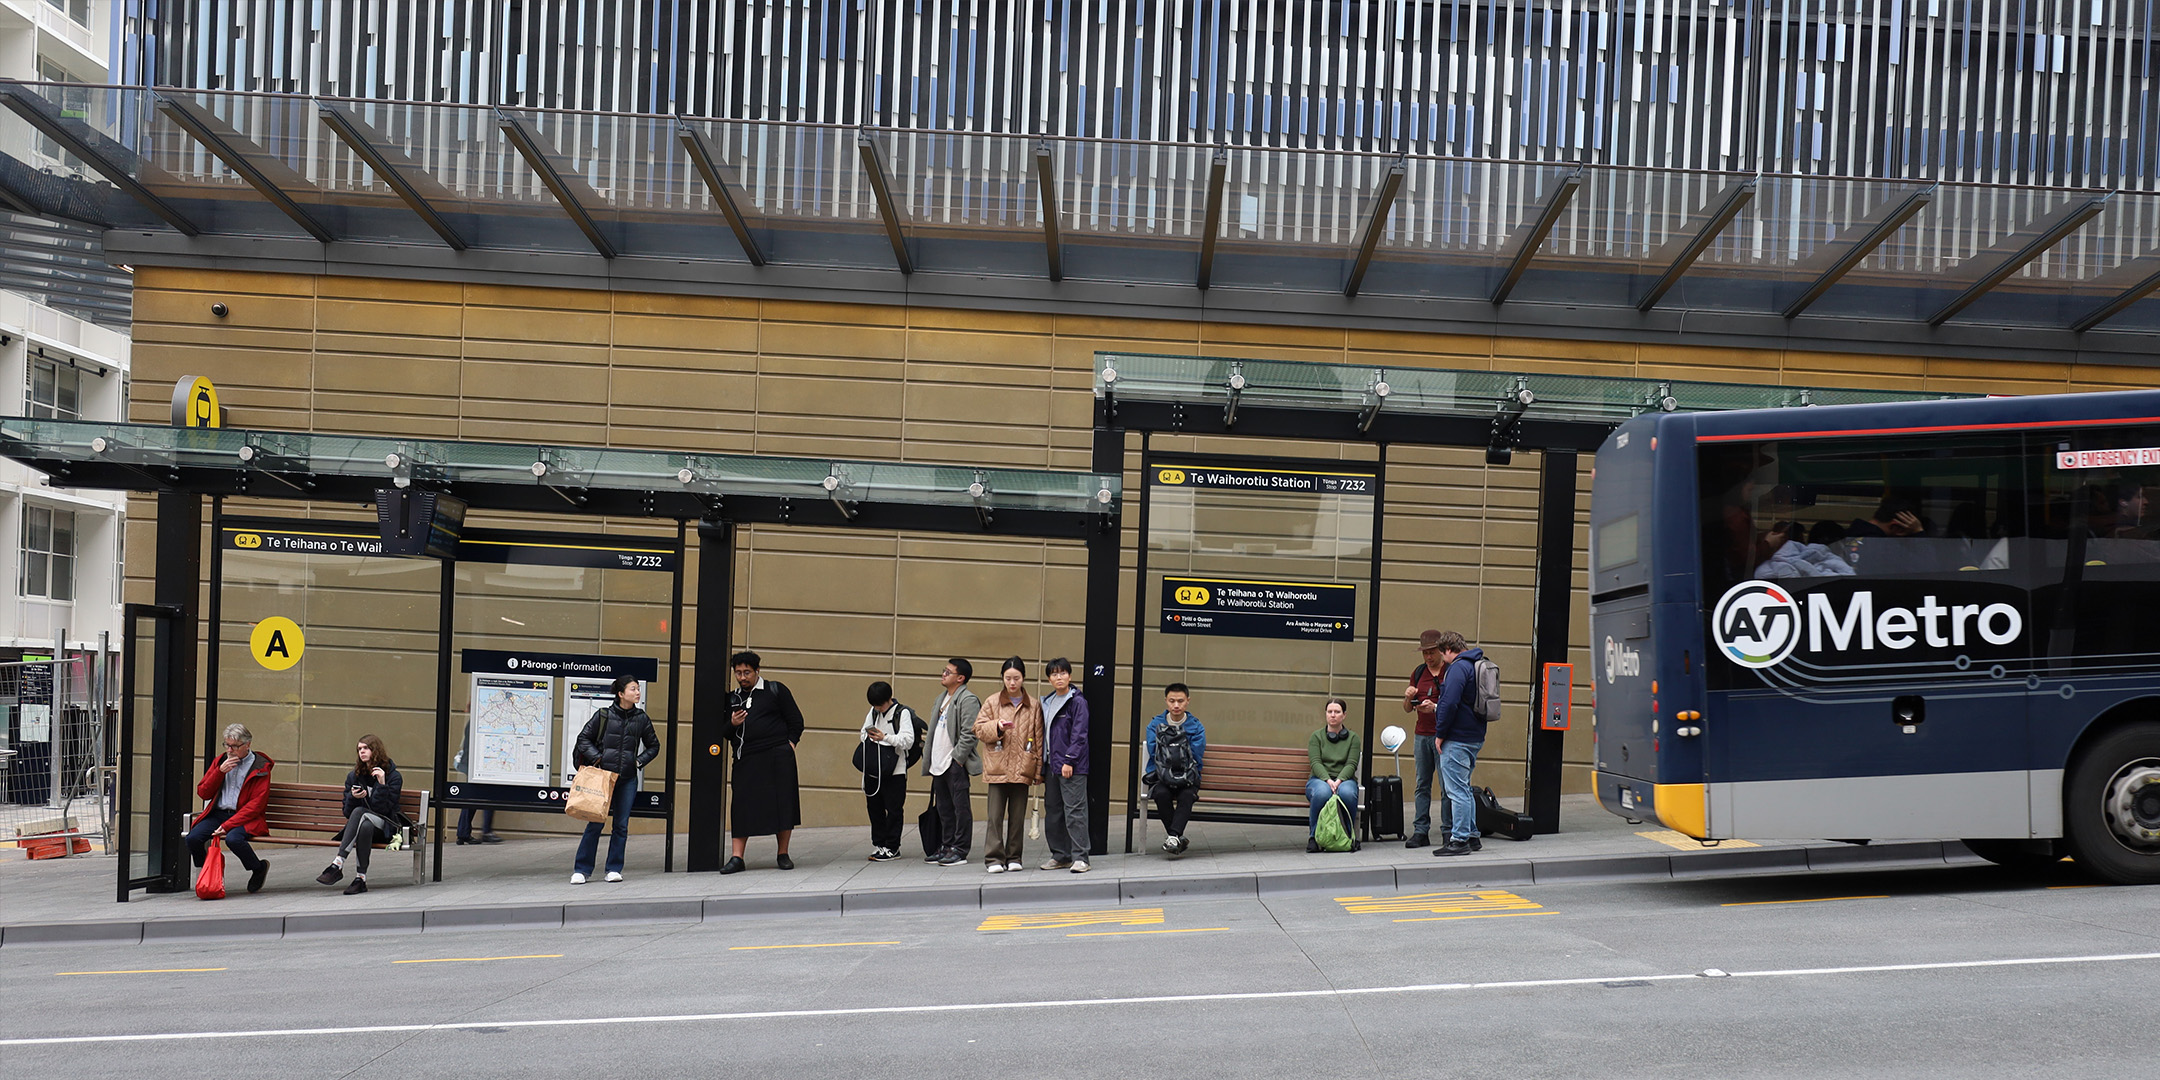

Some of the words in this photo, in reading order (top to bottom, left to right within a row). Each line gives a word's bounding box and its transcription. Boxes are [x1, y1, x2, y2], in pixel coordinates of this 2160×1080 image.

[2081, 450, 2138, 466] EMERGENCY
[1174, 473, 1181, 481] A
[1190, 472, 1204, 483] Te
[1207, 473, 1269, 487] Waihorotiu
[1271, 476, 1311, 489] Station
[1339, 479, 1366, 491] 7232
[250, 537, 257, 545] A
[267, 536, 281, 549] Te
[283, 537, 327, 551] Teihana
[330, 542, 337, 551] o
[340, 540, 354, 552] Te
[635, 555, 662, 567] 7232
[1196, 591, 1204, 600] A
[1217, 588, 1226, 597] Te
[1228, 588, 1257, 598] Teihana
[1265, 590, 1274, 599] Te
[1275, 591, 1317, 601] Waihorotiu
[1216, 598, 1225, 606] Te
[1227, 598, 1267, 608] Waihorotiu
[1268, 600, 1295, 609] Station
[1807, 590, 2022, 653] Metro
[265, 629, 290, 658] A
[521, 659, 558, 672] Pārongo
[562, 661, 612, 673] Information
